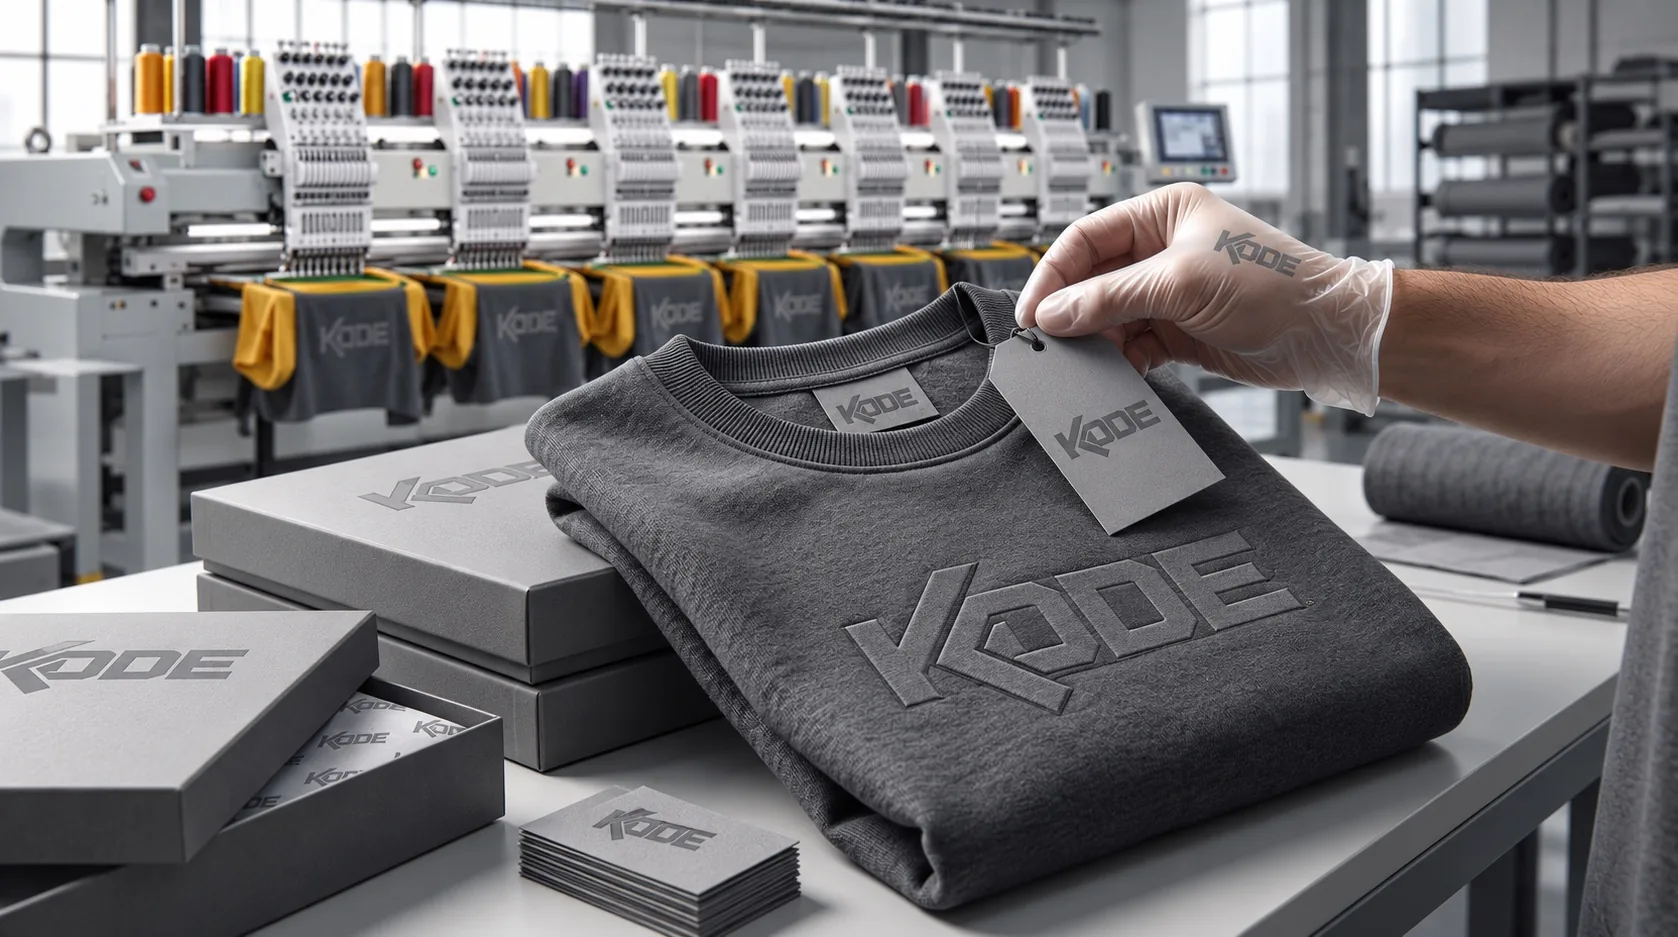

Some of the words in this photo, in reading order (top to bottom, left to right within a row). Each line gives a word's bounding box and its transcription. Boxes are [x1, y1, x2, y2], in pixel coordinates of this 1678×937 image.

[1214, 229, 1301, 277] KODE
[496, 305, 558, 344] KODE
[651, 297, 704, 331] KODE
[773, 290, 822, 322] KODE
[319, 316, 390, 358] KODE
[836, 387, 919, 425] KODE
[1053, 400, 1161, 460] KODE
[843, 530, 1306, 715] KODE
[317, 731, 390, 750] KODE
[412, 719, 467, 738] KOD
[592, 807, 718, 851] KODE
